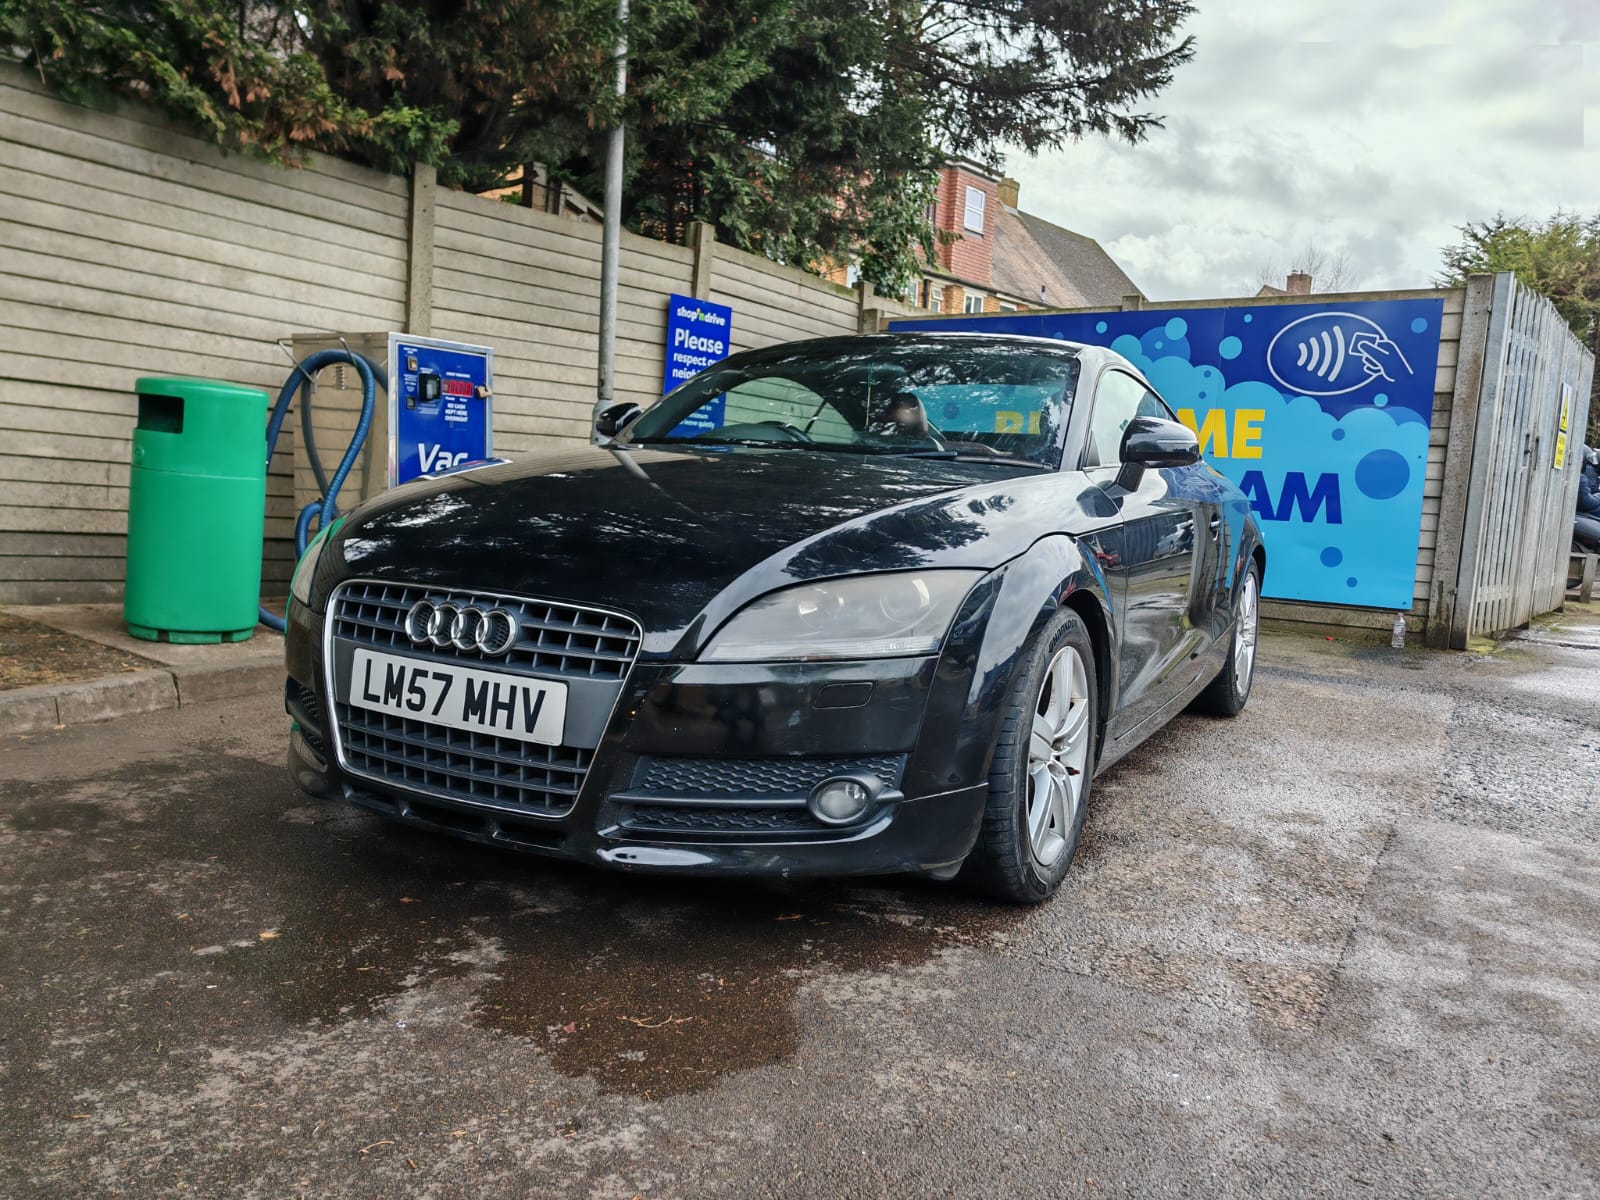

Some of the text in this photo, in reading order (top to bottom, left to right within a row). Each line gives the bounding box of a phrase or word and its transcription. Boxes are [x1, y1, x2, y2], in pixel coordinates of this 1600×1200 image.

[675, 328, 724, 354] Please
[673, 353, 706, 367] respect
[418, 443, 468, 473] Vac
[363, 658, 546, 734] LM57 MHV
